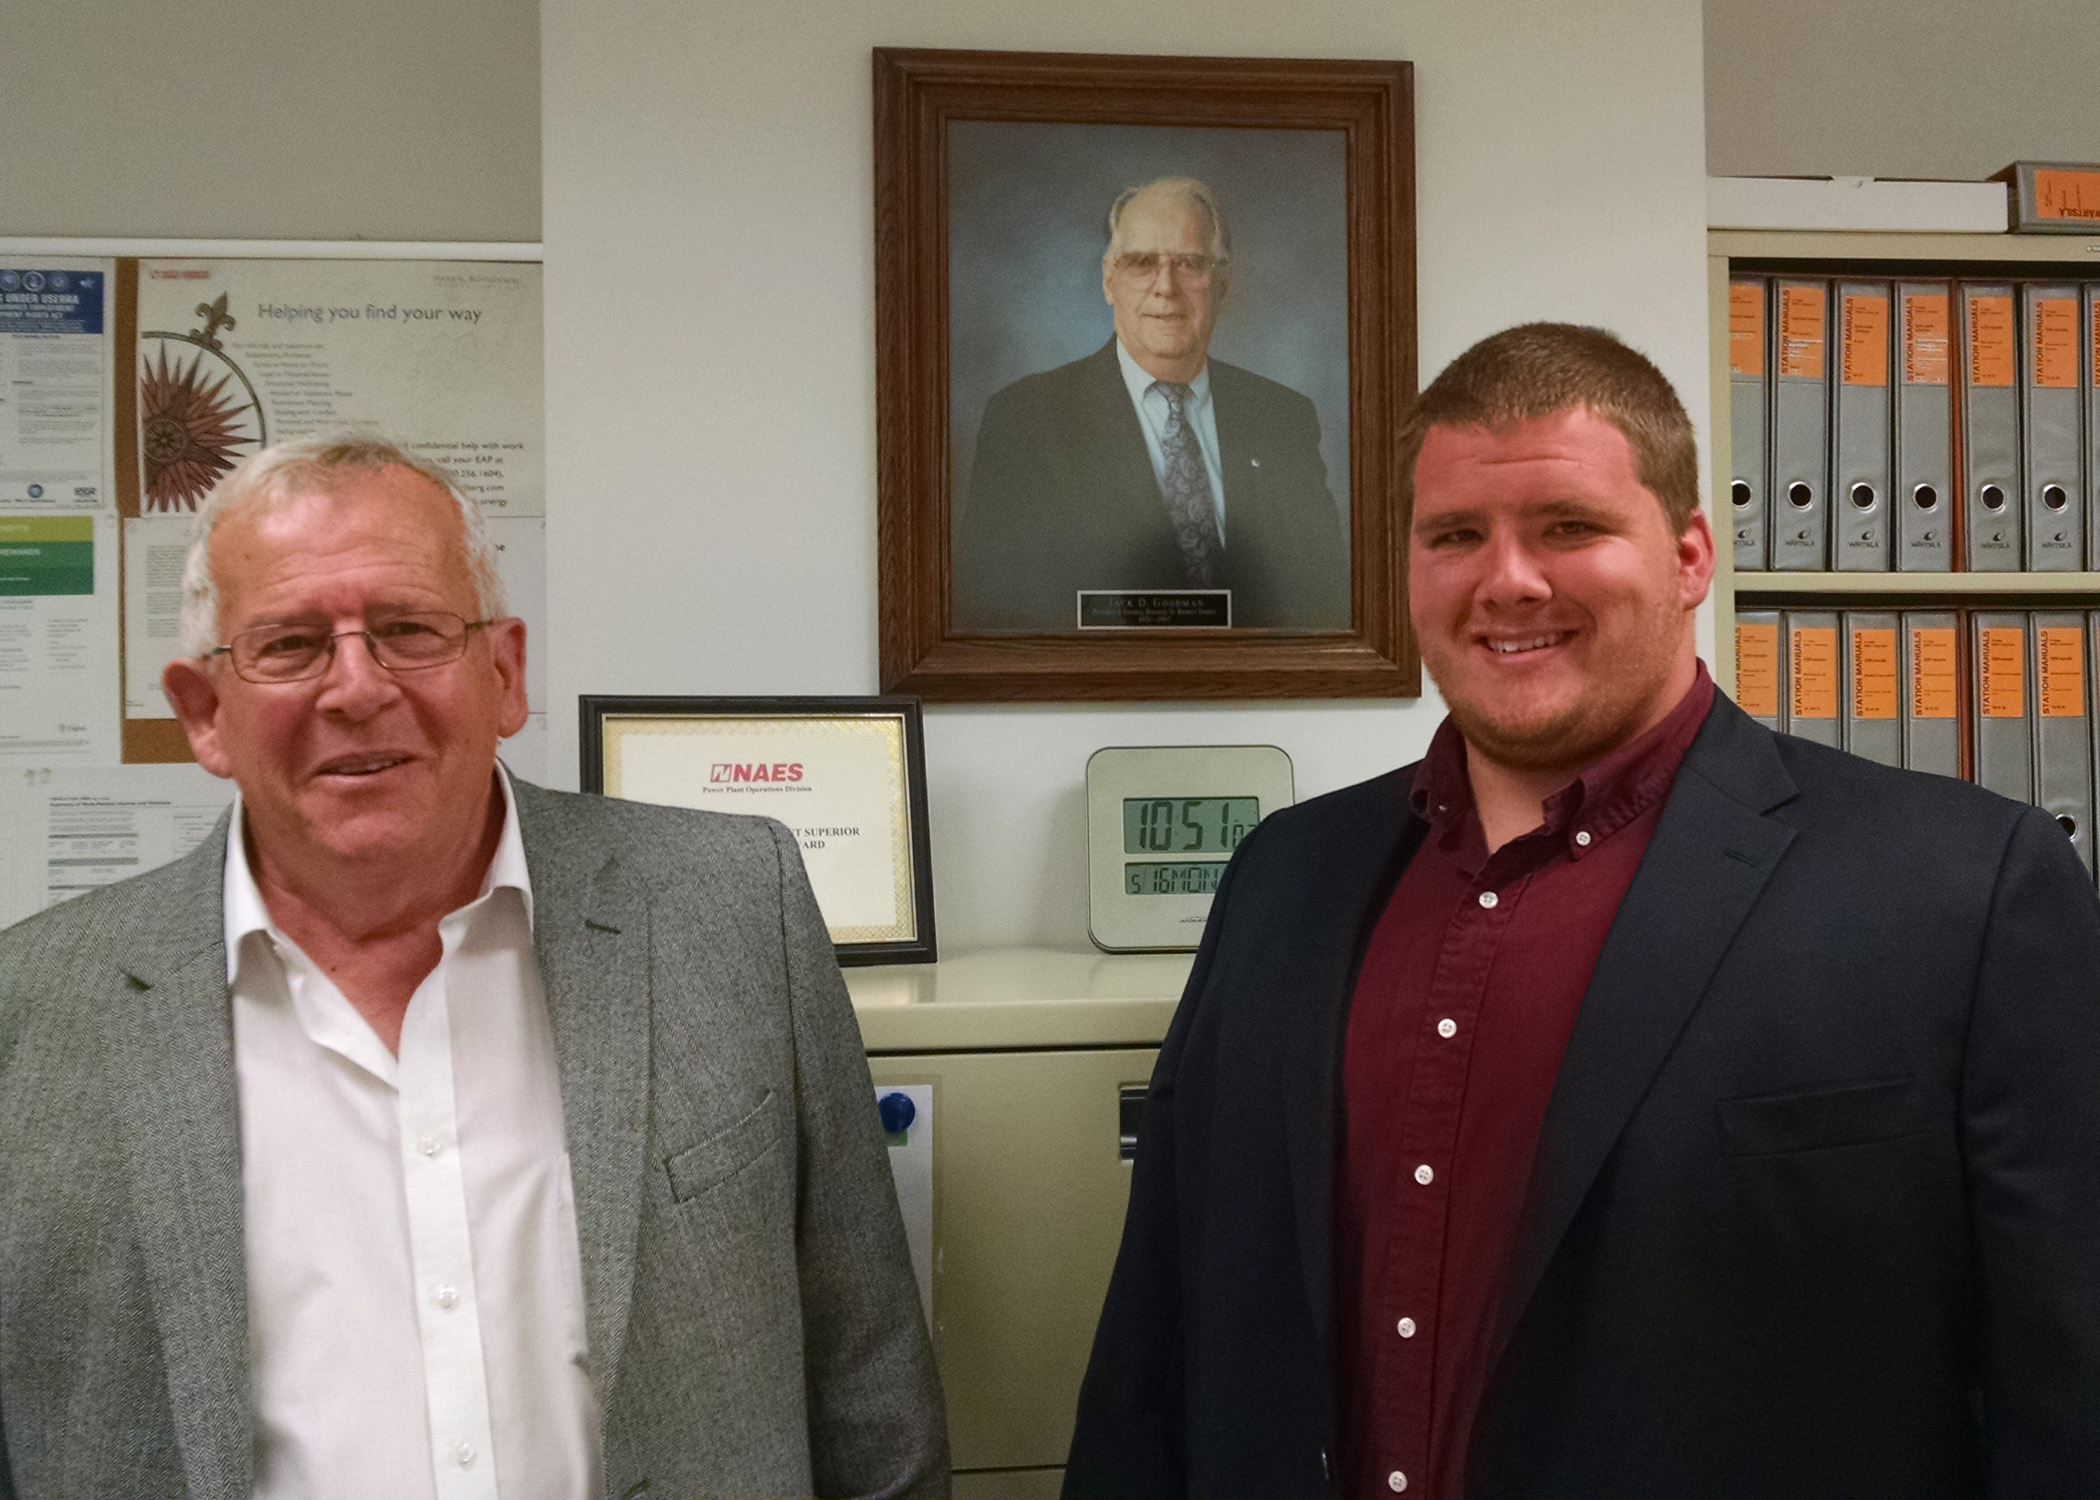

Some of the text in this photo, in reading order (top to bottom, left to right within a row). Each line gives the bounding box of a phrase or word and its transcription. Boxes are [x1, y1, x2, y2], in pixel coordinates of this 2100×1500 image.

[257, 303, 482, 325] Helping you find your way
[1781, 289, 1791, 333] MANUALS
[1844, 298, 1854, 382] STATION MANUALS
[1905, 298, 1915, 382] STATION MANUALS
[1970, 299, 1980, 383] STATION MANUALS
[2035, 301, 2044, 385] STATION MANUALS
[481, 442, 499, 450] with
[502, 442, 524, 450] work
[1794, 631, 1803, 716] STATION MANUALS
[1855, 632, 1864, 717] STATION MANUALS
[1913, 631, 1923, 716] STATION MANUALS
[1982, 630, 1991, 715] STATION MANUALS
[2041, 630, 2050, 715] STATION MANUALS
[702, 786, 724, 794] Power
[746, 786, 784, 794] Operations
[733, 763, 804, 783] NAES
[801, 841, 826, 850] ARD
[804, 828, 860, 837] SUPERIOR
